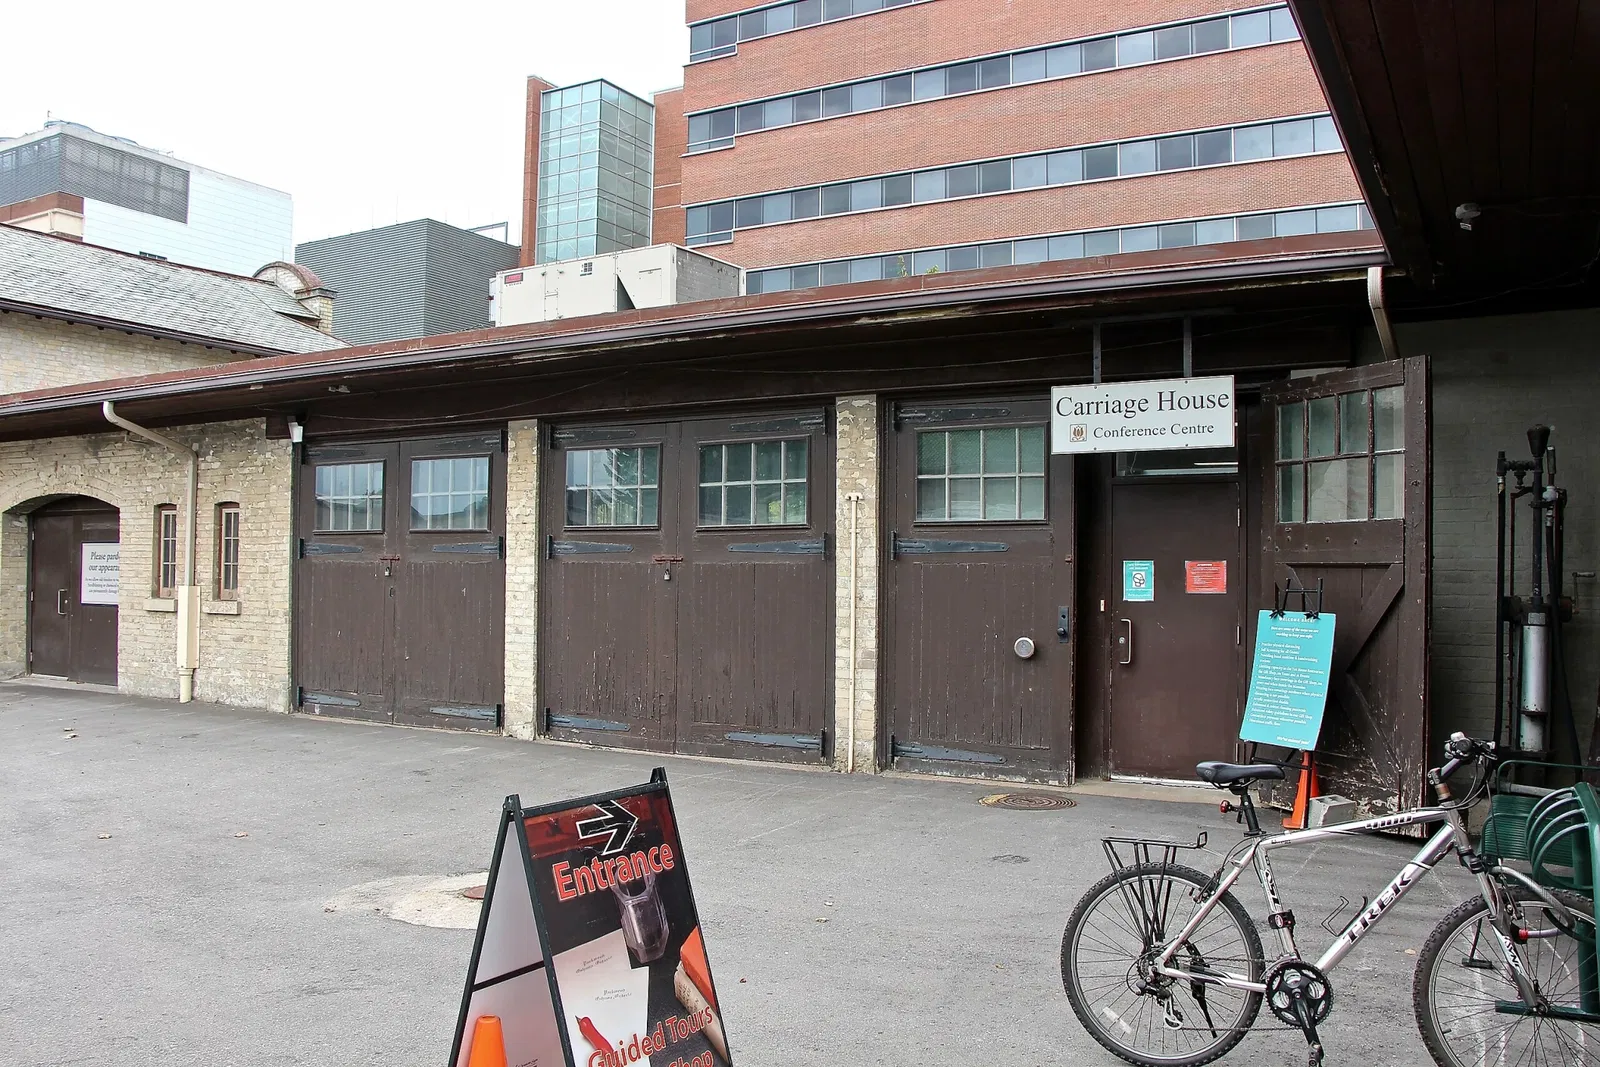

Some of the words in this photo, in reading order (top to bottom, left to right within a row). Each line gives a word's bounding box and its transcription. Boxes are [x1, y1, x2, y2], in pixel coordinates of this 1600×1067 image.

[1056, 393, 1149, 419] Carriage
[1157, 390, 1230, 411] House
[1093, 425, 1166, 439] Conference
[1170, 423, 1215, 435] Centre
[90, 551, 106, 561] Please
[552, 843, 676, 903] Entrance
[1342, 871, 1412, 944] TREK
[587, 1021, 666, 1067] Guided
[665, 1005, 713, 1044] Tours
